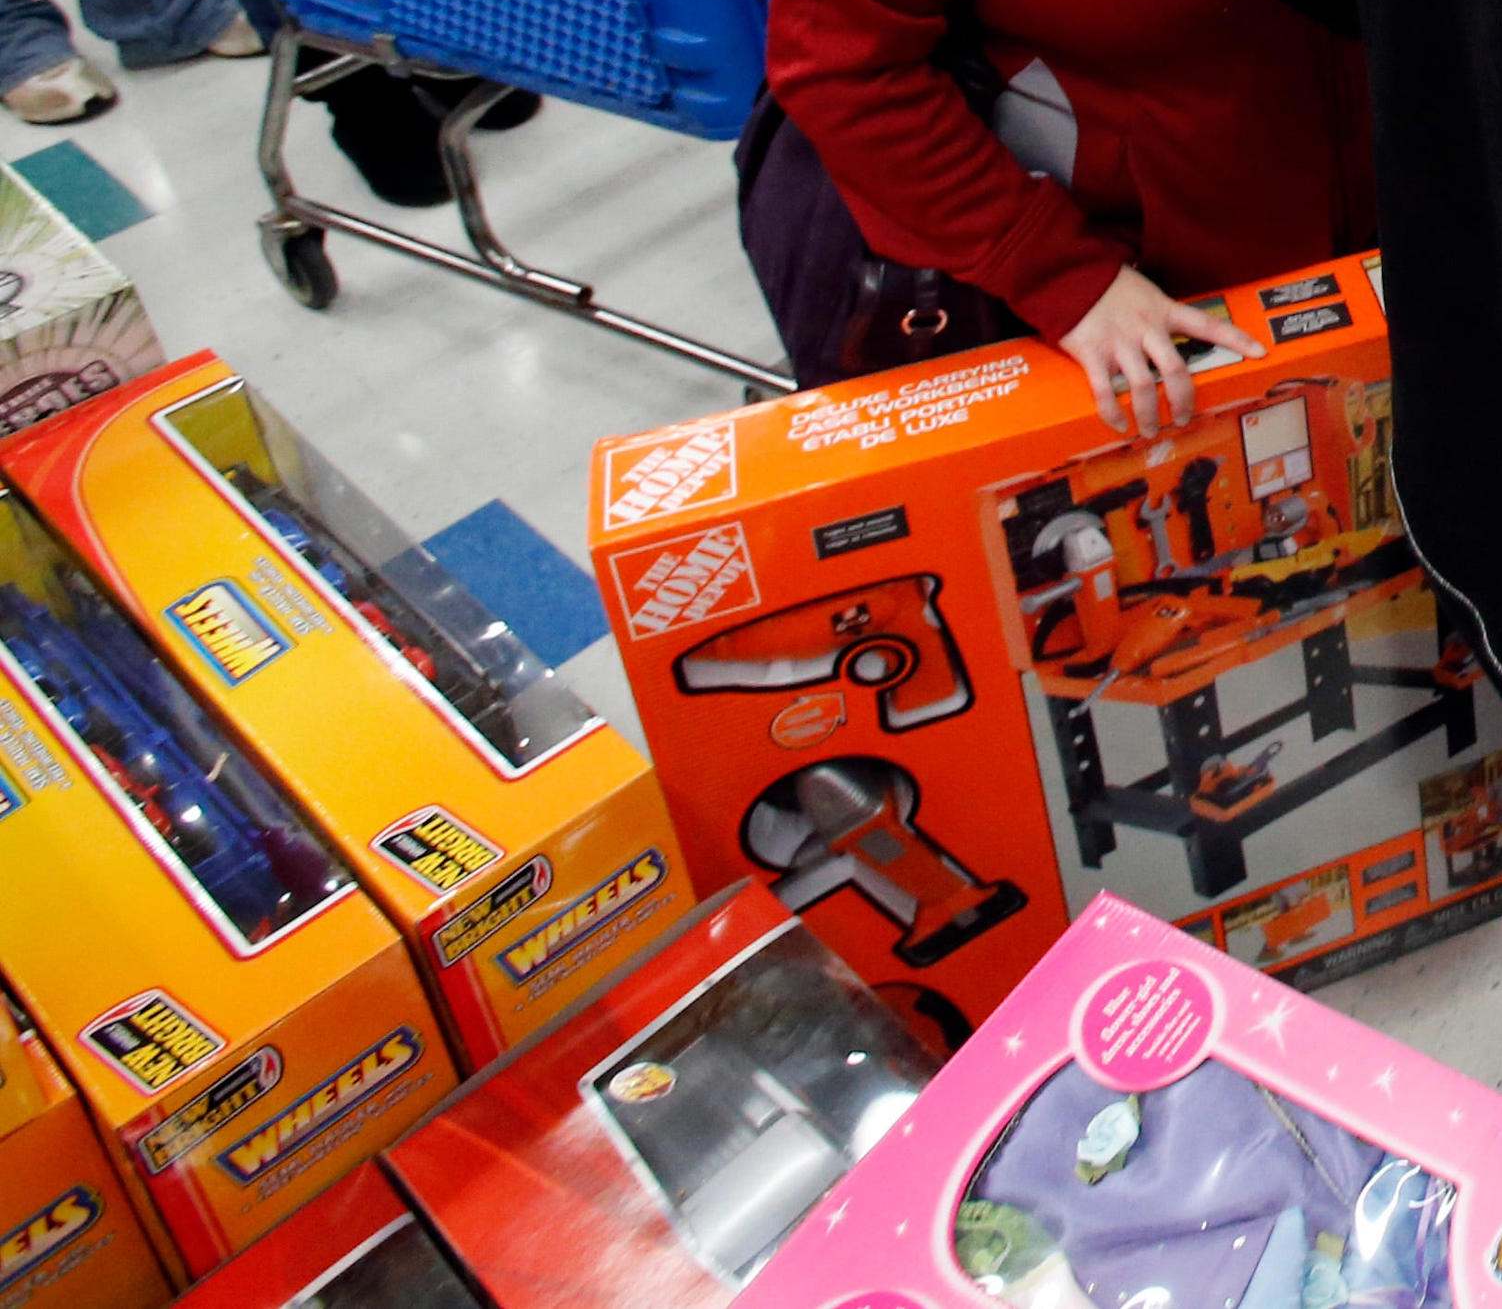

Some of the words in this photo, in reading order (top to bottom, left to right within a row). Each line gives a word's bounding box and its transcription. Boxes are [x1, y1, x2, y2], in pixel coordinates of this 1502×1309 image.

[788, 410, 860, 441] CASE
[868, 364, 1031, 419] WORKBENCH
[792, 389, 891, 429] DELUXE
[898, 354, 1026, 396] CARRYING
[900, 380, 1021, 425] PORTATIF
[860, 430, 896, 450] DE
[904, 409, 970, 438] LUXE
[608, 427, 727, 523] HOME
[620, 446, 673, 485] THE
[658, 449, 733, 513] DEPOT
[632, 524, 745, 635] HOME
[635, 552, 684, 592] THE
[682, 551, 750, 621] DEPOT
[176, 593, 284, 677] WHEELS
[408, 853, 468, 892] NEW
[418, 815, 496, 870] BRIGHT
[440, 901, 493, 944] NEW
[444, 887, 534, 963] BRIGHT
[509, 857, 663, 970] WHEELS
[1322, 933, 1396, 969] WARNING
[134, 994, 223, 1063] BRIGHT
[122, 1045, 182, 1089] NEW
[227, 1035, 419, 1176] WHEELS
